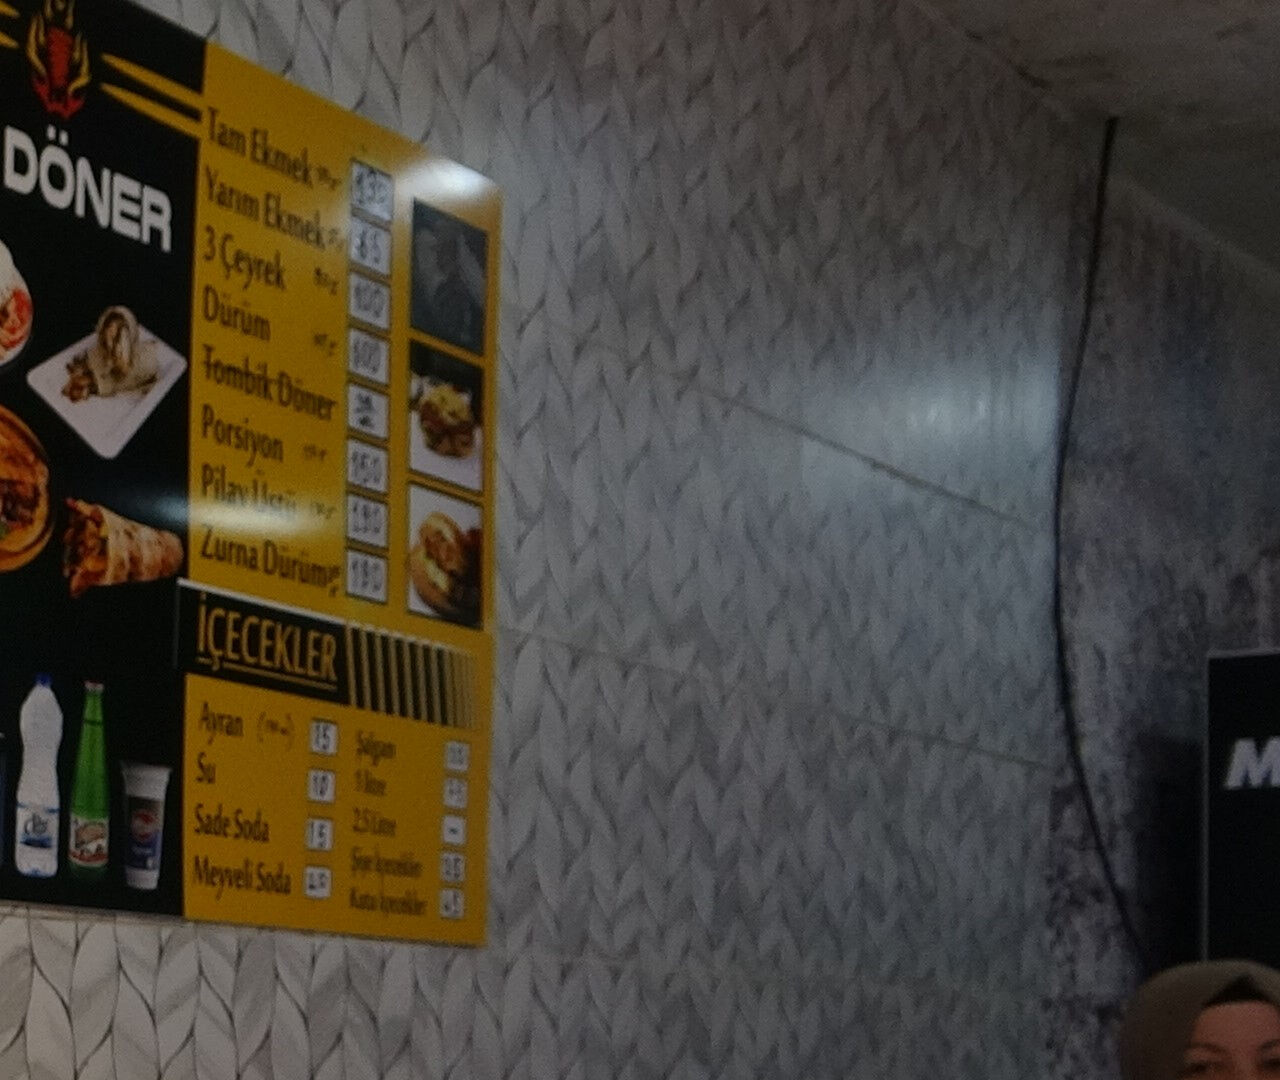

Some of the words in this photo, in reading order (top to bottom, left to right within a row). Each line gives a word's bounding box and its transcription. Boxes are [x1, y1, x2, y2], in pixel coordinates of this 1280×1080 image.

[206, 106, 246, 157] Tam
[250, 127, 312, 188] Ekmek
[4, 126, 172, 252] DÖNER
[204, 165, 259, 221] Yarım
[264, 192, 325, 249] Ekmek
[203, 225, 216, 261] 3
[220, 233, 286, 290] Çeyrek
[202, 284, 271, 341] Dürüm
[201, 344, 273, 402] Tombik
[277, 372, 338, 421] Döner
[201, 404, 284, 465] Porsiyon
[201, 523, 259, 570] Zurna
[263, 540, 328, 588] Dürüm
[197, 592, 338, 681] İÇECEKLER
[197, 702, 243, 744] Ayran
[196, 752, 216, 785] Su
[194, 803, 230, 838] Sade
[235, 808, 270, 843] Soda
[193, 854, 251, 901] Meyveli
[256, 861, 292, 896] Soda
